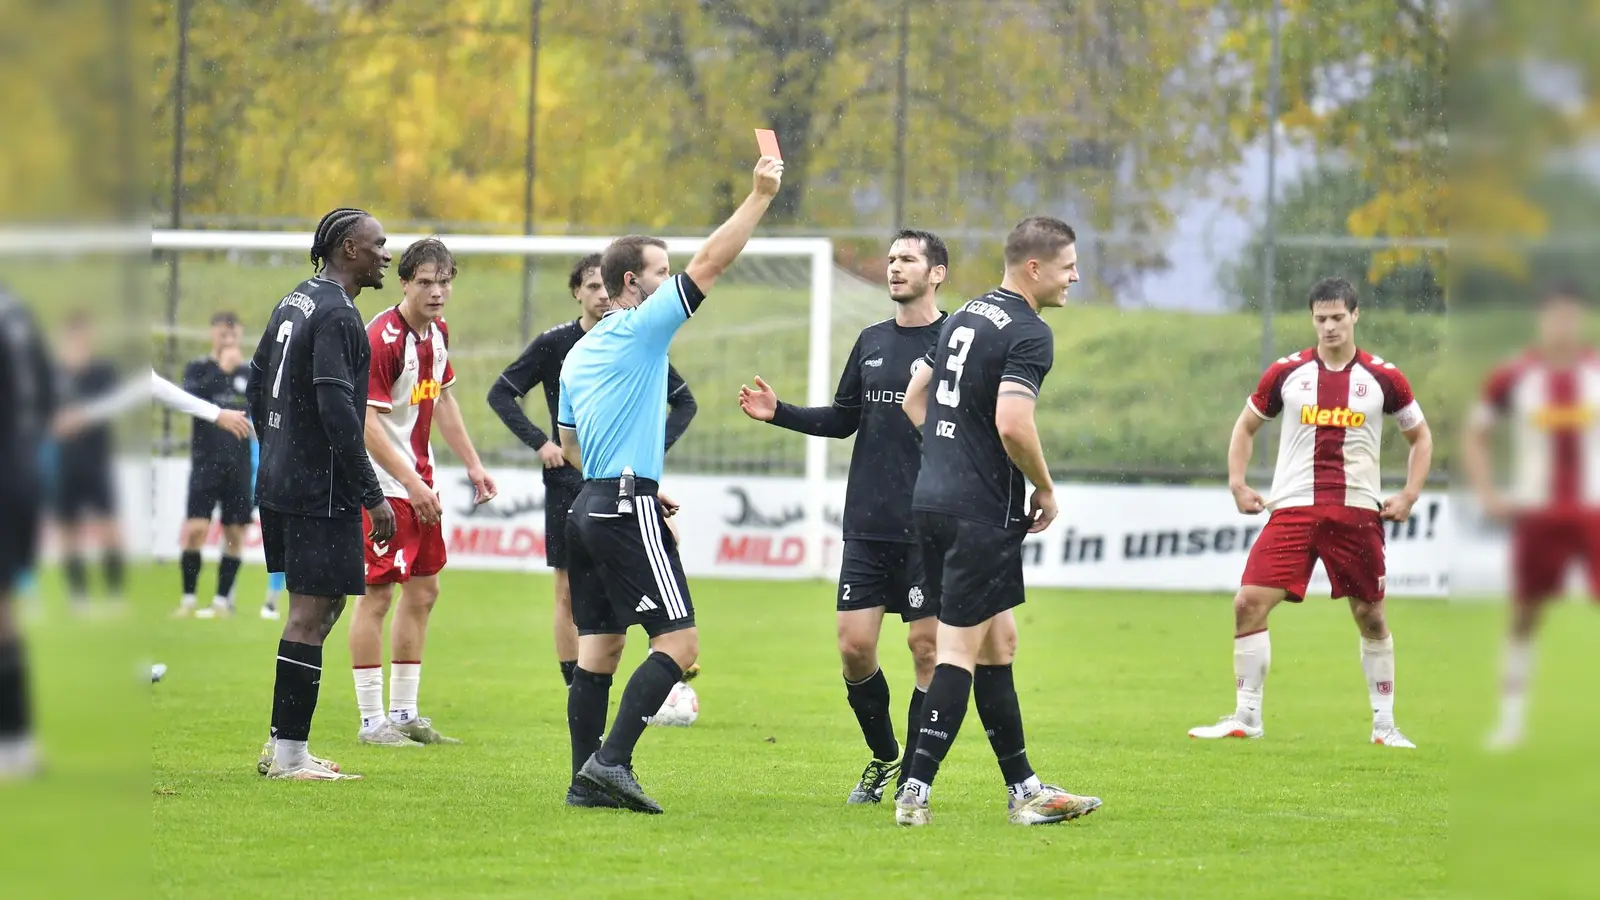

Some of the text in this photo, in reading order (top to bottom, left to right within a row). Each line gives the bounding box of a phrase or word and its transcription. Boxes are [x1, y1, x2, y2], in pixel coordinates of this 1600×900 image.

[272, 320, 293, 399] 7
[935, 325, 976, 409] 3
[1300, 403, 1367, 429] Netto
[1062, 527, 1103, 564] in
[393, 548, 407, 575] 4
[841, 583, 851, 601] 2
[930, 709, 939, 722] 3
